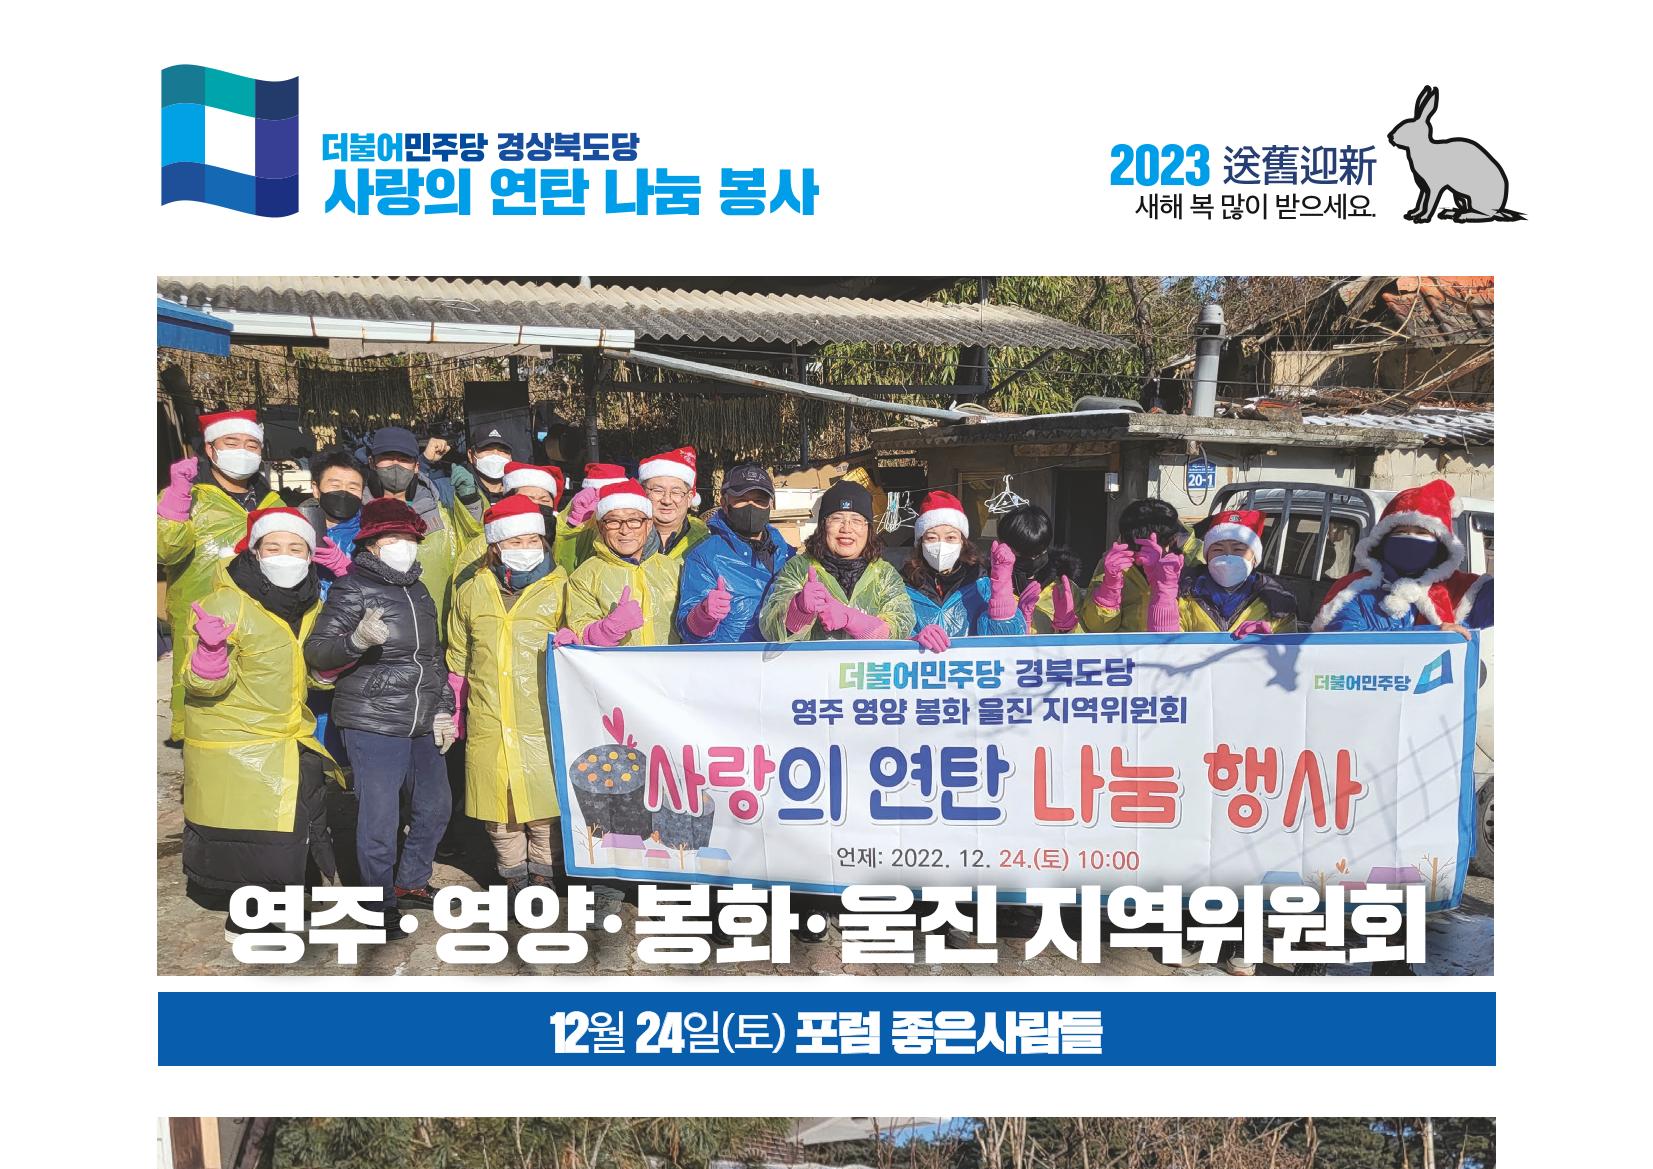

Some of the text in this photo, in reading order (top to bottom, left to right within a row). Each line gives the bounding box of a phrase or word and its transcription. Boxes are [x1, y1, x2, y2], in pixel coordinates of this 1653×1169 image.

[1188, 474, 1213, 487] 20-1
[838, 657, 1136, 690] 더불어민주당 경북도당
[1313, 673, 1412, 692] 더불어민주당
[791, 696, 1187, 725] 영주 영양 봉화 울진 지역위원회
[647, 743, 1363, 831] 사랑의 연탄 나눔 행사
[836, 846, 1140, 871] 언제: 2022. 12. 24.(토) 10:00
